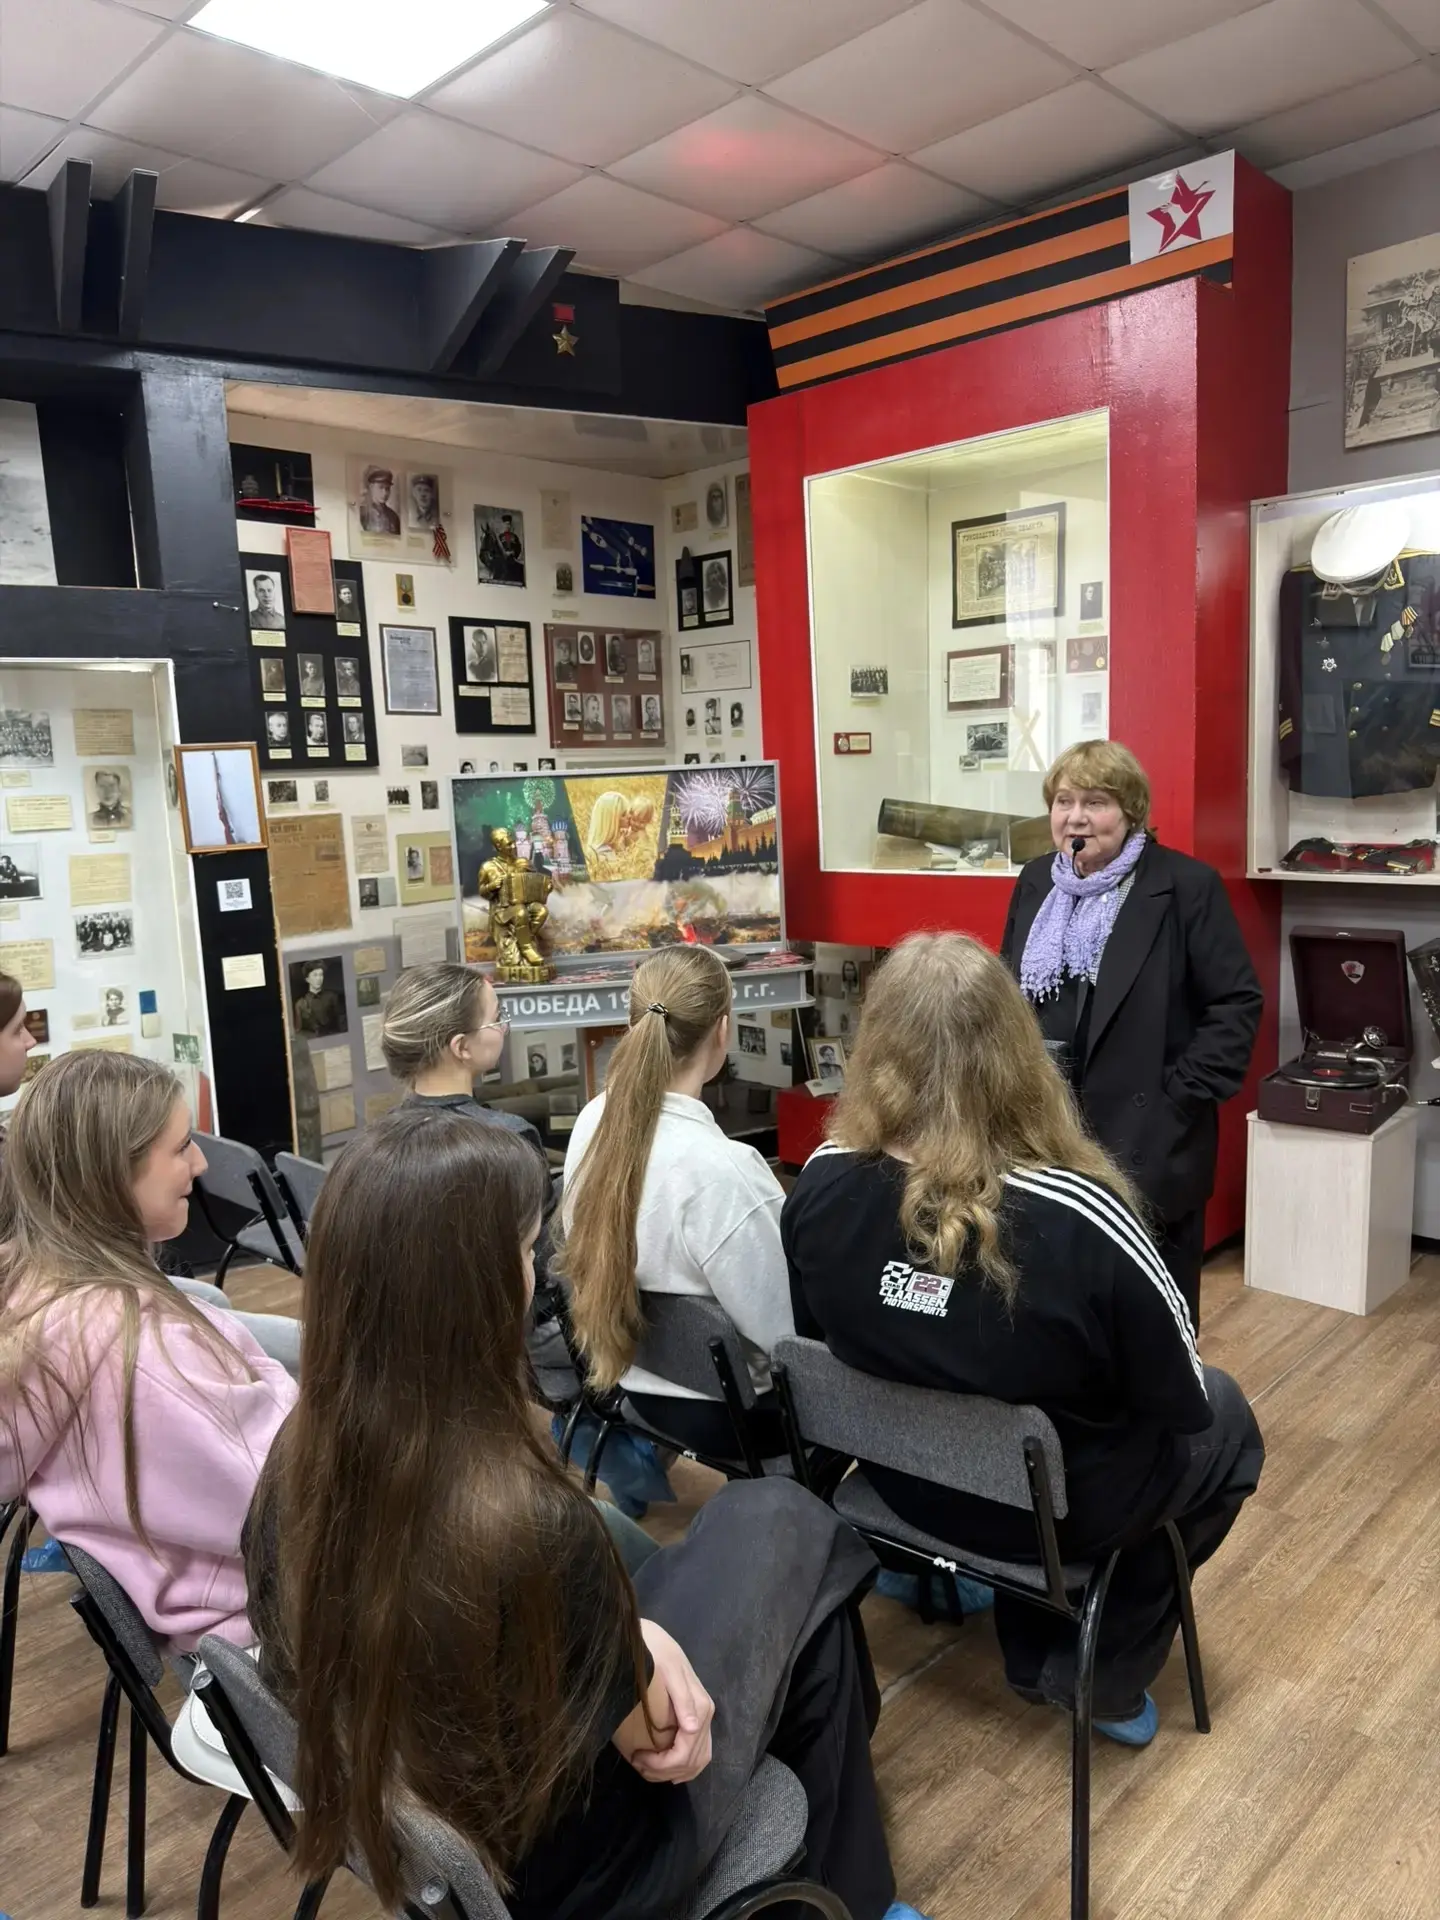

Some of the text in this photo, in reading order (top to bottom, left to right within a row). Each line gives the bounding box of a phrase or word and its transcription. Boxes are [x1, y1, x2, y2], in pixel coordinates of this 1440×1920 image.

[502, 993, 601, 1016] ПОБЕДА
[913, 1275, 942, 1295] 22
[879, 1286, 948, 1309] CLAASSEN
[882, 1296, 948, 1318] MOTORSPORTS
